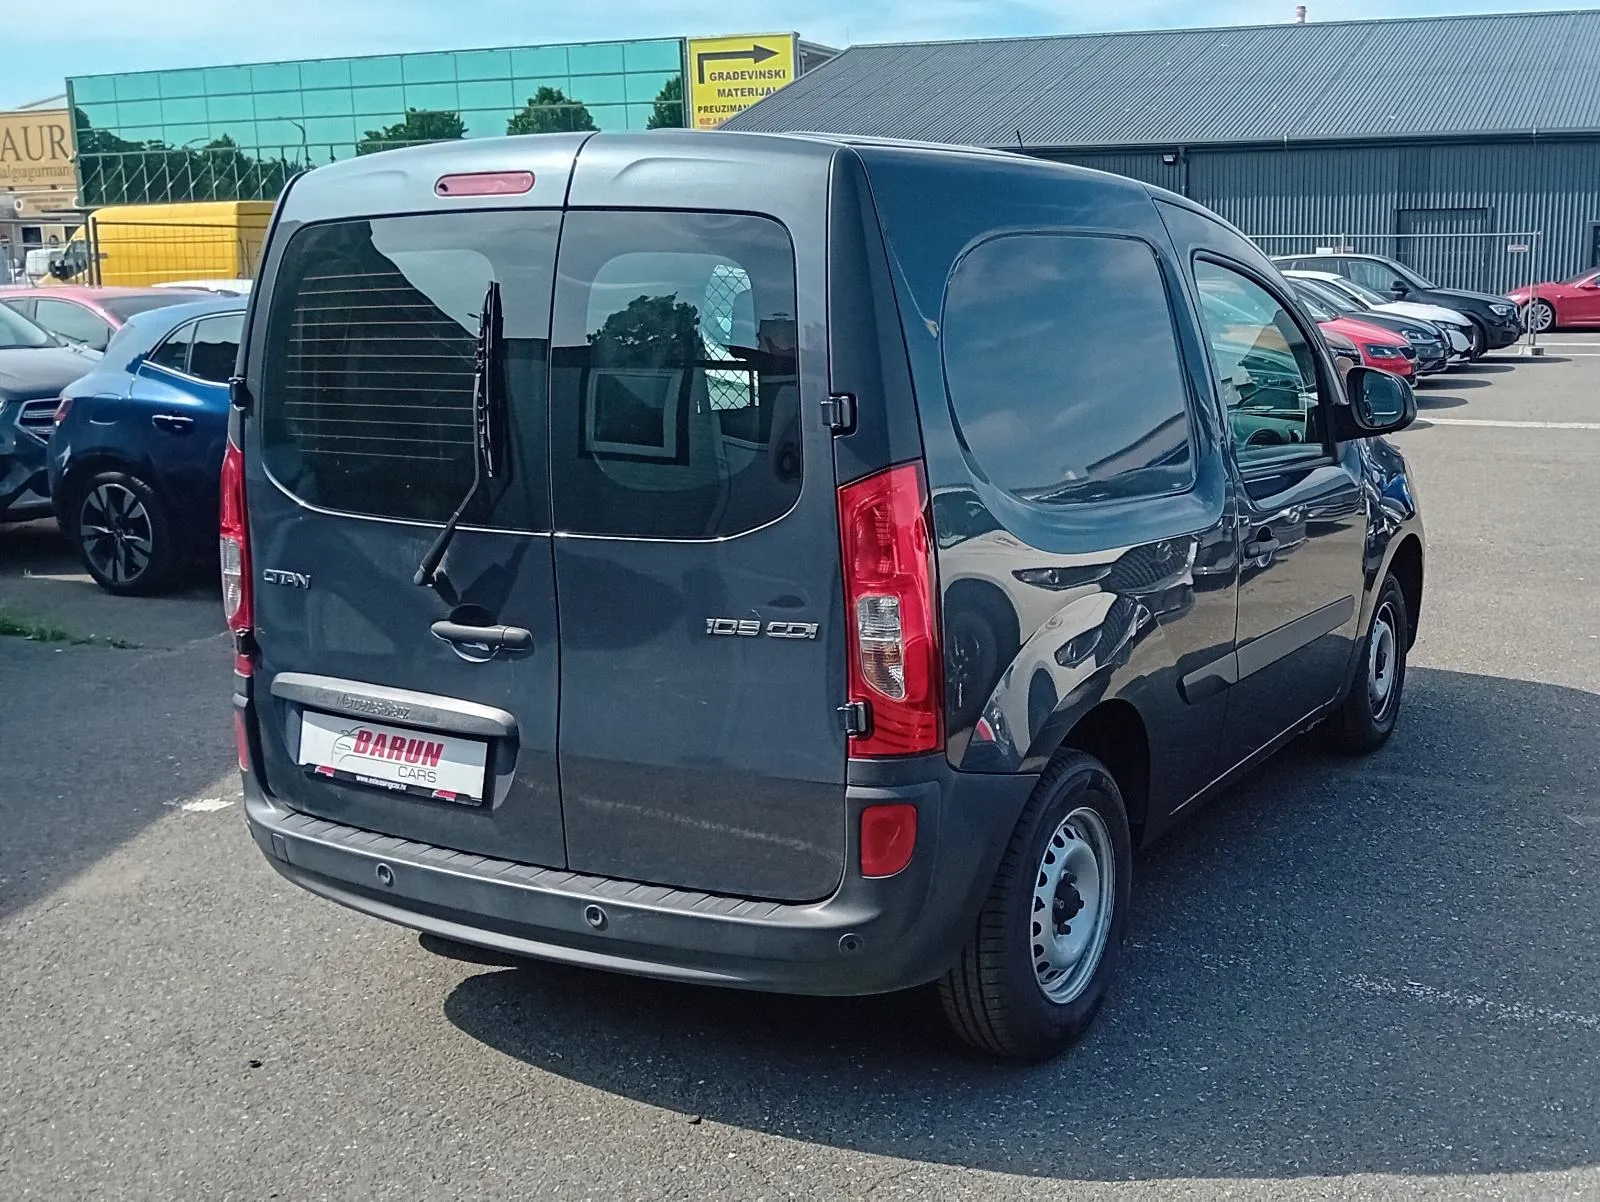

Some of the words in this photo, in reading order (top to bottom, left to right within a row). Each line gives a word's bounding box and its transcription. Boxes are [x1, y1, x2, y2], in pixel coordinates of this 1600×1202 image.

[709, 69, 786, 82] GRAĐEVINSKI
[0, 125, 70, 162] AUR
[766, 621, 819, 639] CDI
[353, 729, 444, 767] BARUN
[397, 765, 437, 783] CARS
